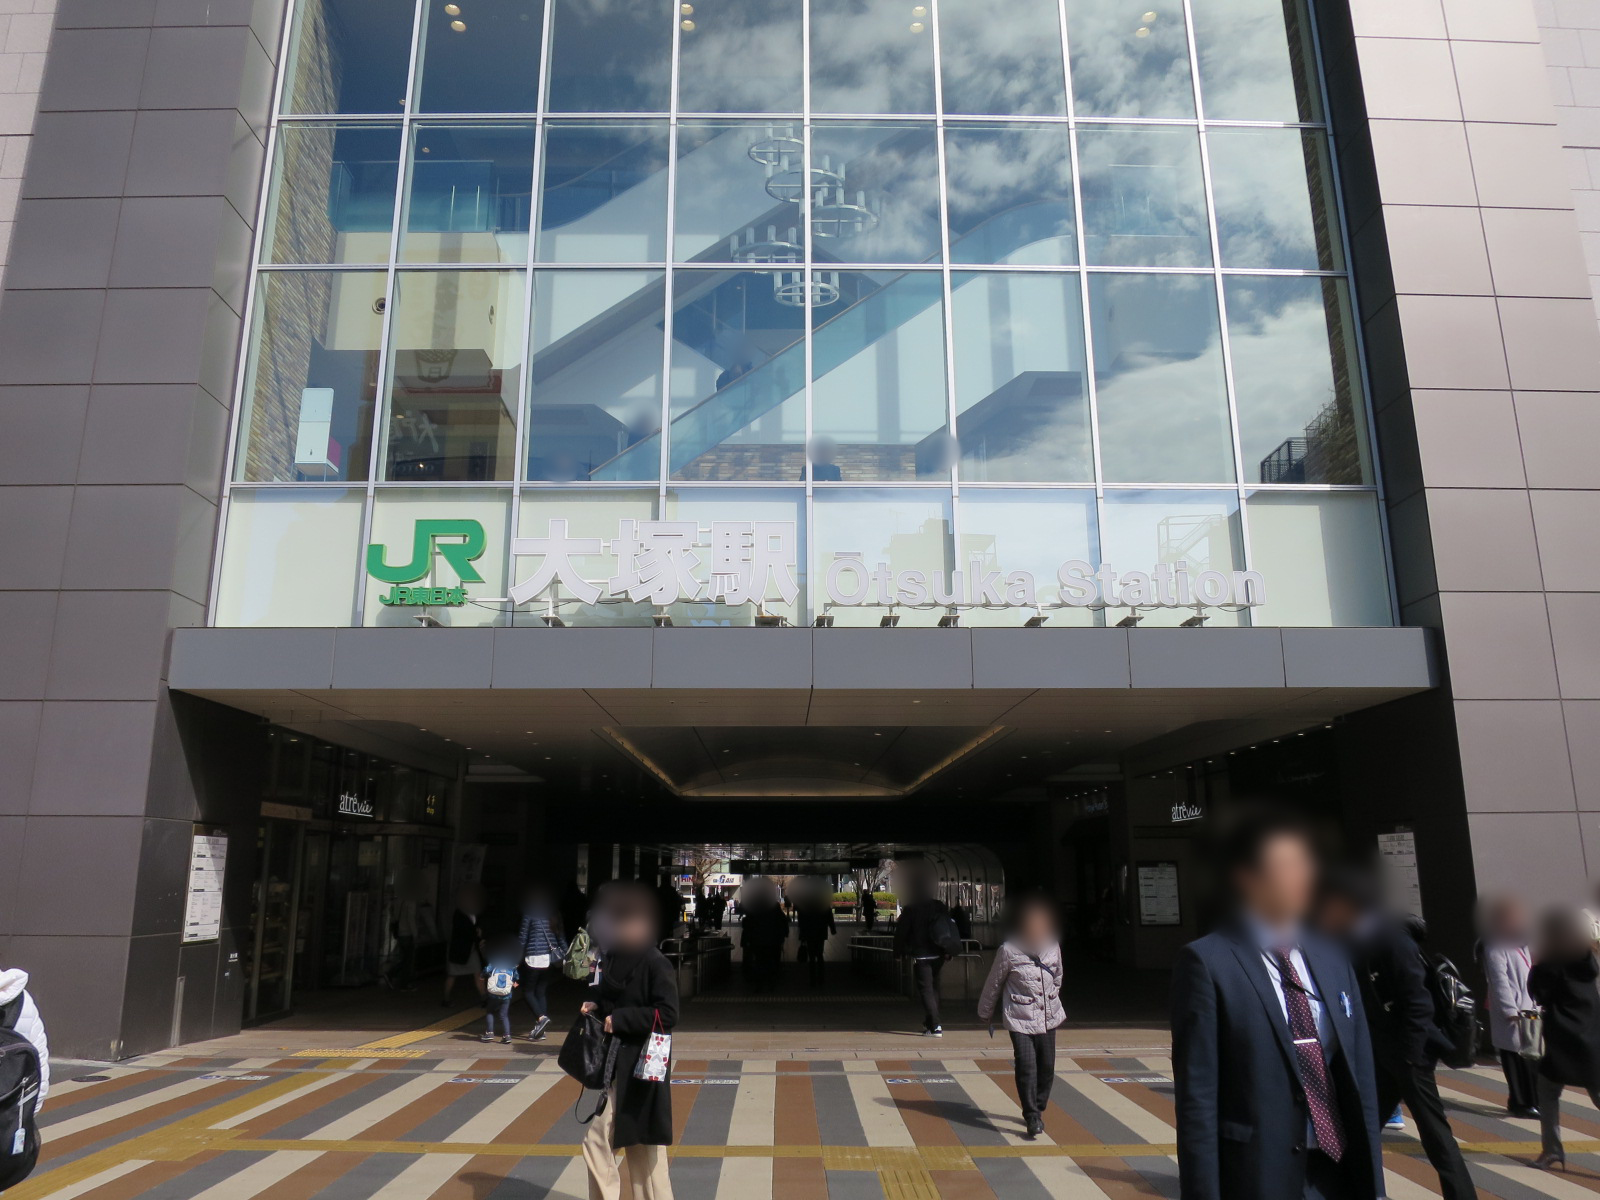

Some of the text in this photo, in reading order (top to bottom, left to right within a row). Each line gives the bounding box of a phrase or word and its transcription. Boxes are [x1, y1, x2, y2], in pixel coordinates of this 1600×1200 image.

[366, 519, 487, 584] JR
[510, 518, 800, 606] 大塚駅
[825, 551, 1267, 606] Ōtsuka Station
[379, 586, 468, 607] JR東日本
